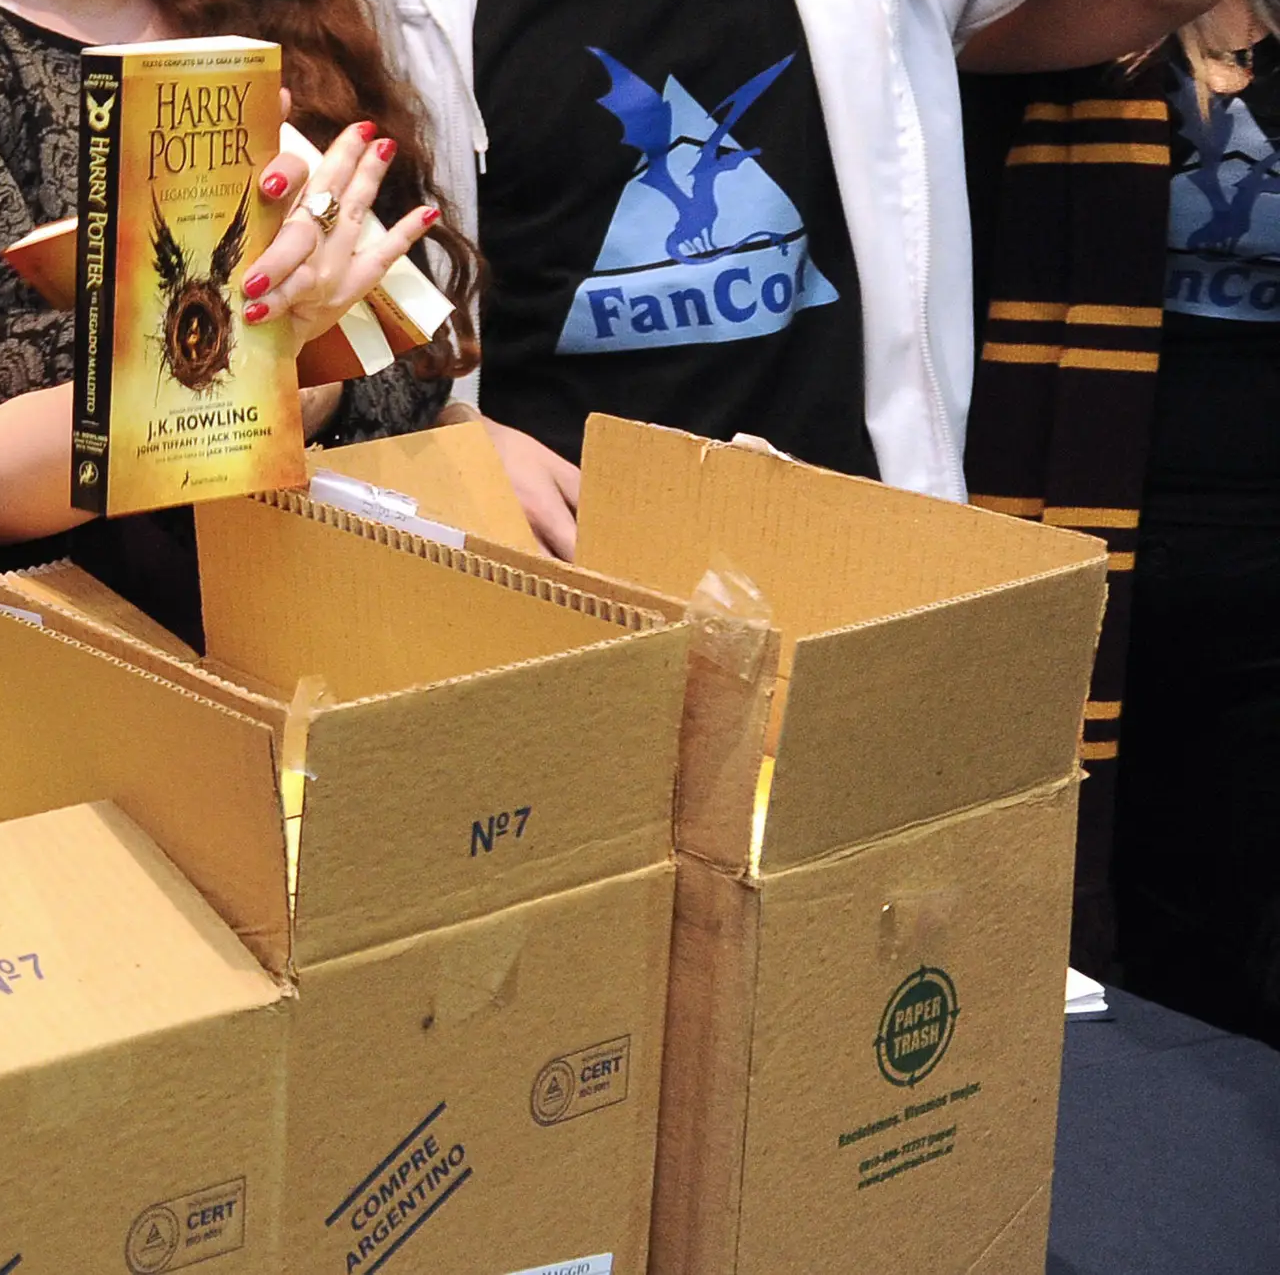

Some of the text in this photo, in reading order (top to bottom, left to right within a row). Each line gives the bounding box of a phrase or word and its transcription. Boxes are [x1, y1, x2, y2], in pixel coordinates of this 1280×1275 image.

[155, 81, 252, 130] HARRY
[88, 136, 111, 207] HARRY
[147, 127, 256, 181] POTTER
[159, 182, 244, 202] LEGADO MALDITO
[86, 211, 109, 290] POTTER
[86, 307, 99, 413] LEGADO MALDITO
[136, 444, 160, 459] JOHN
[162, 436, 198, 452] TIFFANY
[207, 432, 229, 445] JACK
[232, 426, 272, 440] THORNE
[147, 418, 173, 442] J.K.
[176, 407, 258, 433] ROWLING
[895, 995, 943, 1033] PAPER
[894, 1022, 941, 1060] TRASH
[580, 1055, 623, 1083] CERT
[351, 1134, 440, 1232] COMPRE
[186, 1200, 237, 1230] CERT
[346, 1143, 465, 1275] ARGENTINO
